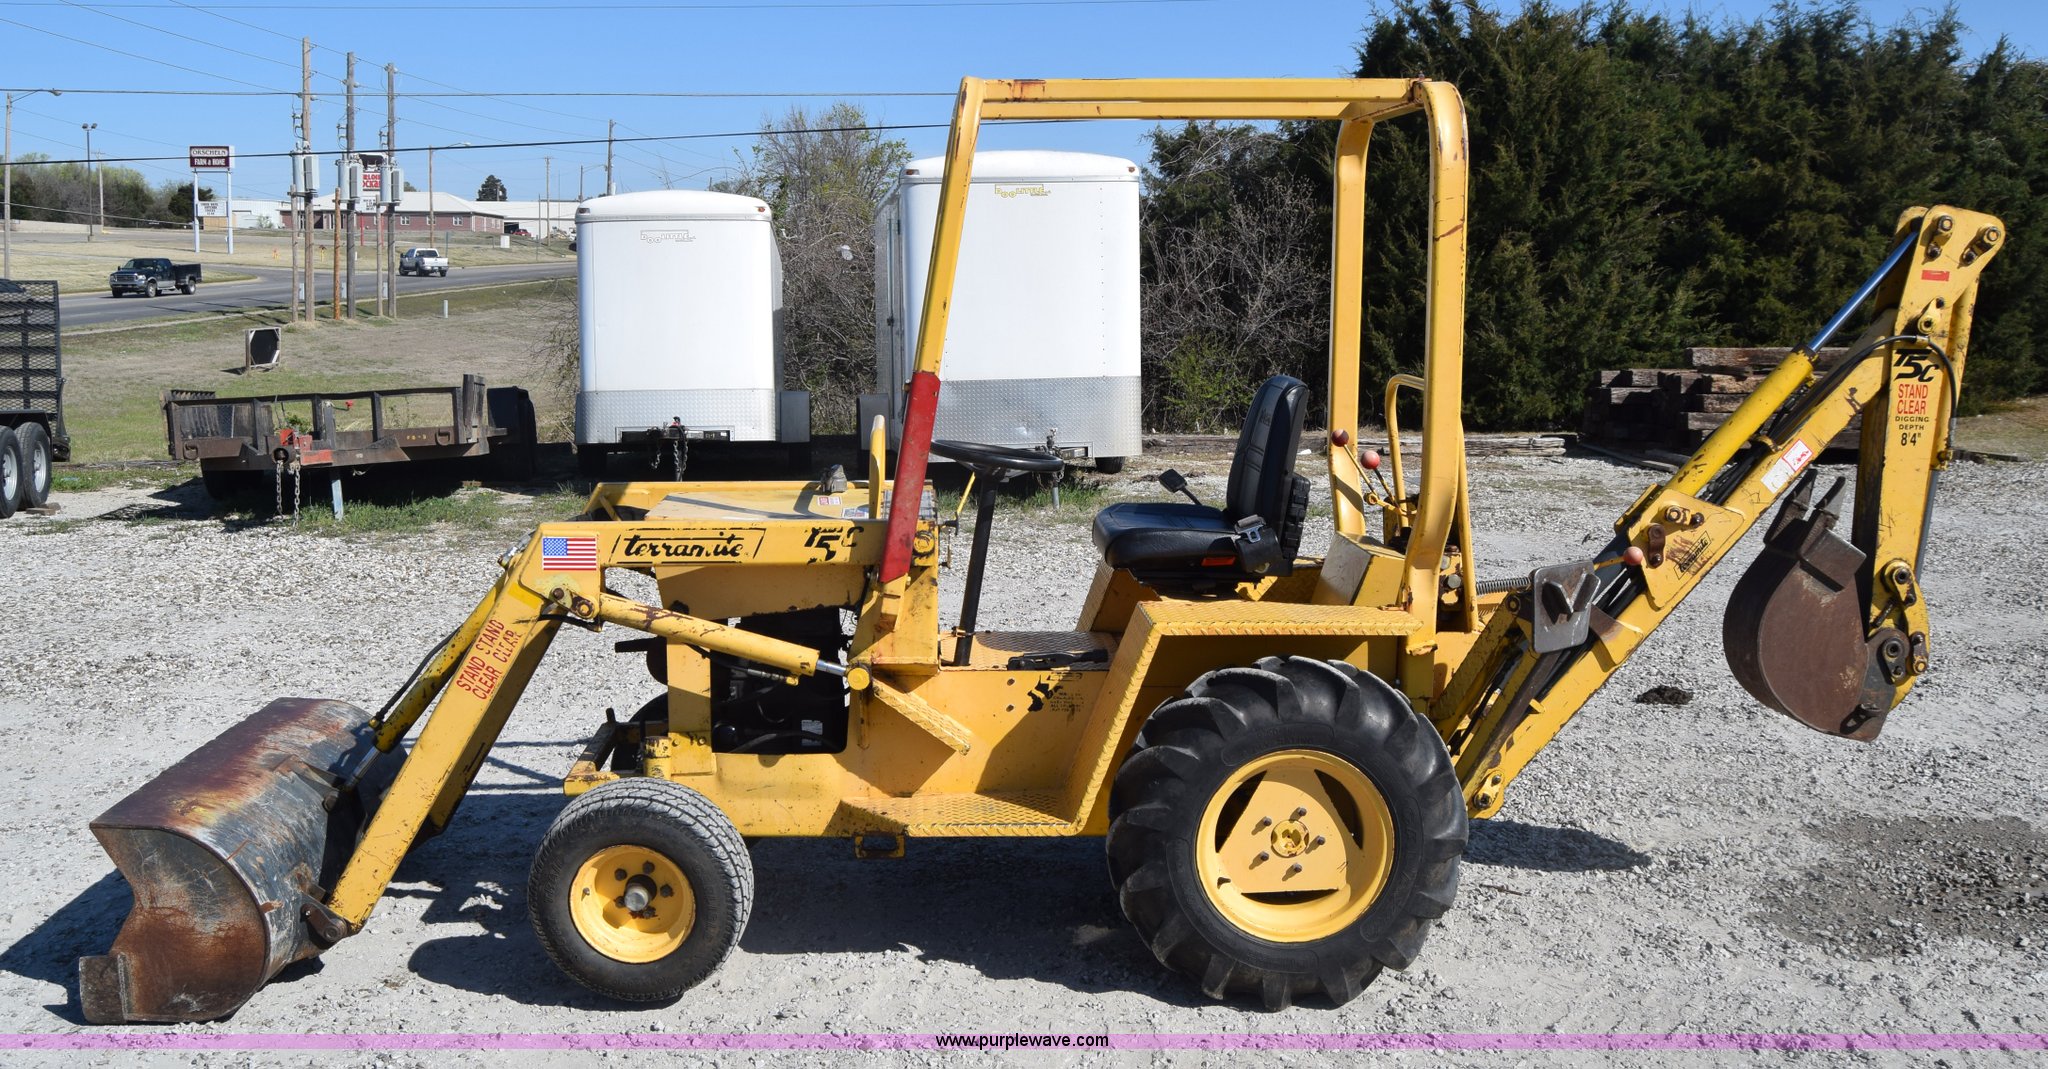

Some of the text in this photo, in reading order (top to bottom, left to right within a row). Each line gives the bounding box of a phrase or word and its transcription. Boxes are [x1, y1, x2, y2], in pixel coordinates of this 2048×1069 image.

[1893, 348, 1940, 383] T5C
[1897, 383, 1929, 399] STAND
[1894, 415, 1930, 423] DIGGING
[1896, 399, 1927, 415] CLEAR
[456, 619, 505, 692] STAND STAND
[472, 629, 523, 700] CLEAR CLEAR
